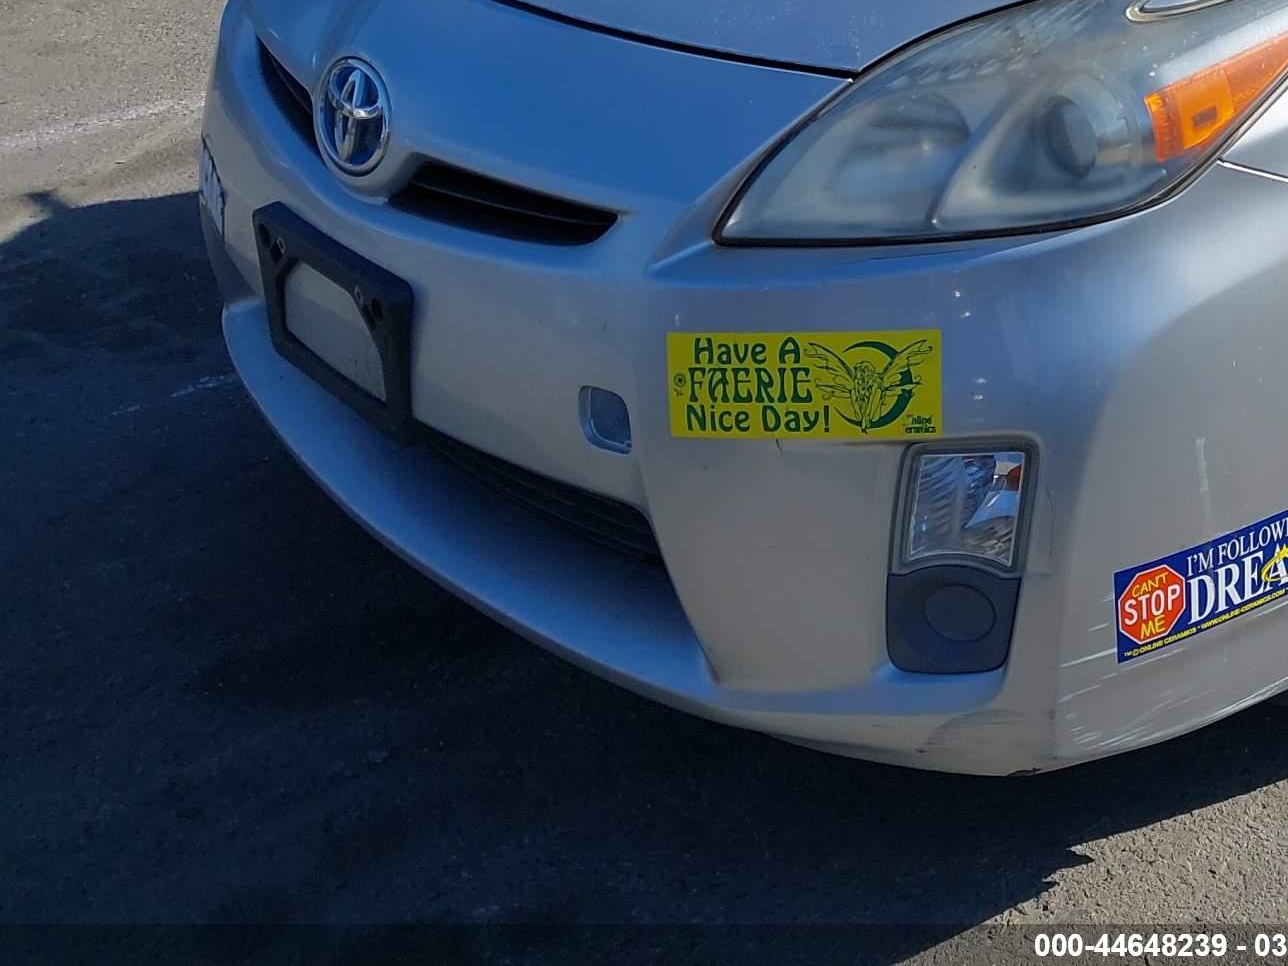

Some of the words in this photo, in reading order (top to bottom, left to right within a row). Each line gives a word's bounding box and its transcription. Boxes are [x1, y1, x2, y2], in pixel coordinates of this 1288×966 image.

[693, 337, 767, 365] Have
[778, 336, 801, 365] A
[688, 366, 814, 404] FAERIE
[685, 404, 750, 433] Nice
[761, 405, 831, 434] Day!
[1186, 548, 1215, 576] I'M
[1123, 585, 1181, 626] STOP
[1139, 639, 1164, 654] ONLINE
[1163, 626, 1198, 645] CERAMICS
[1140, 614, 1166, 640] ME
